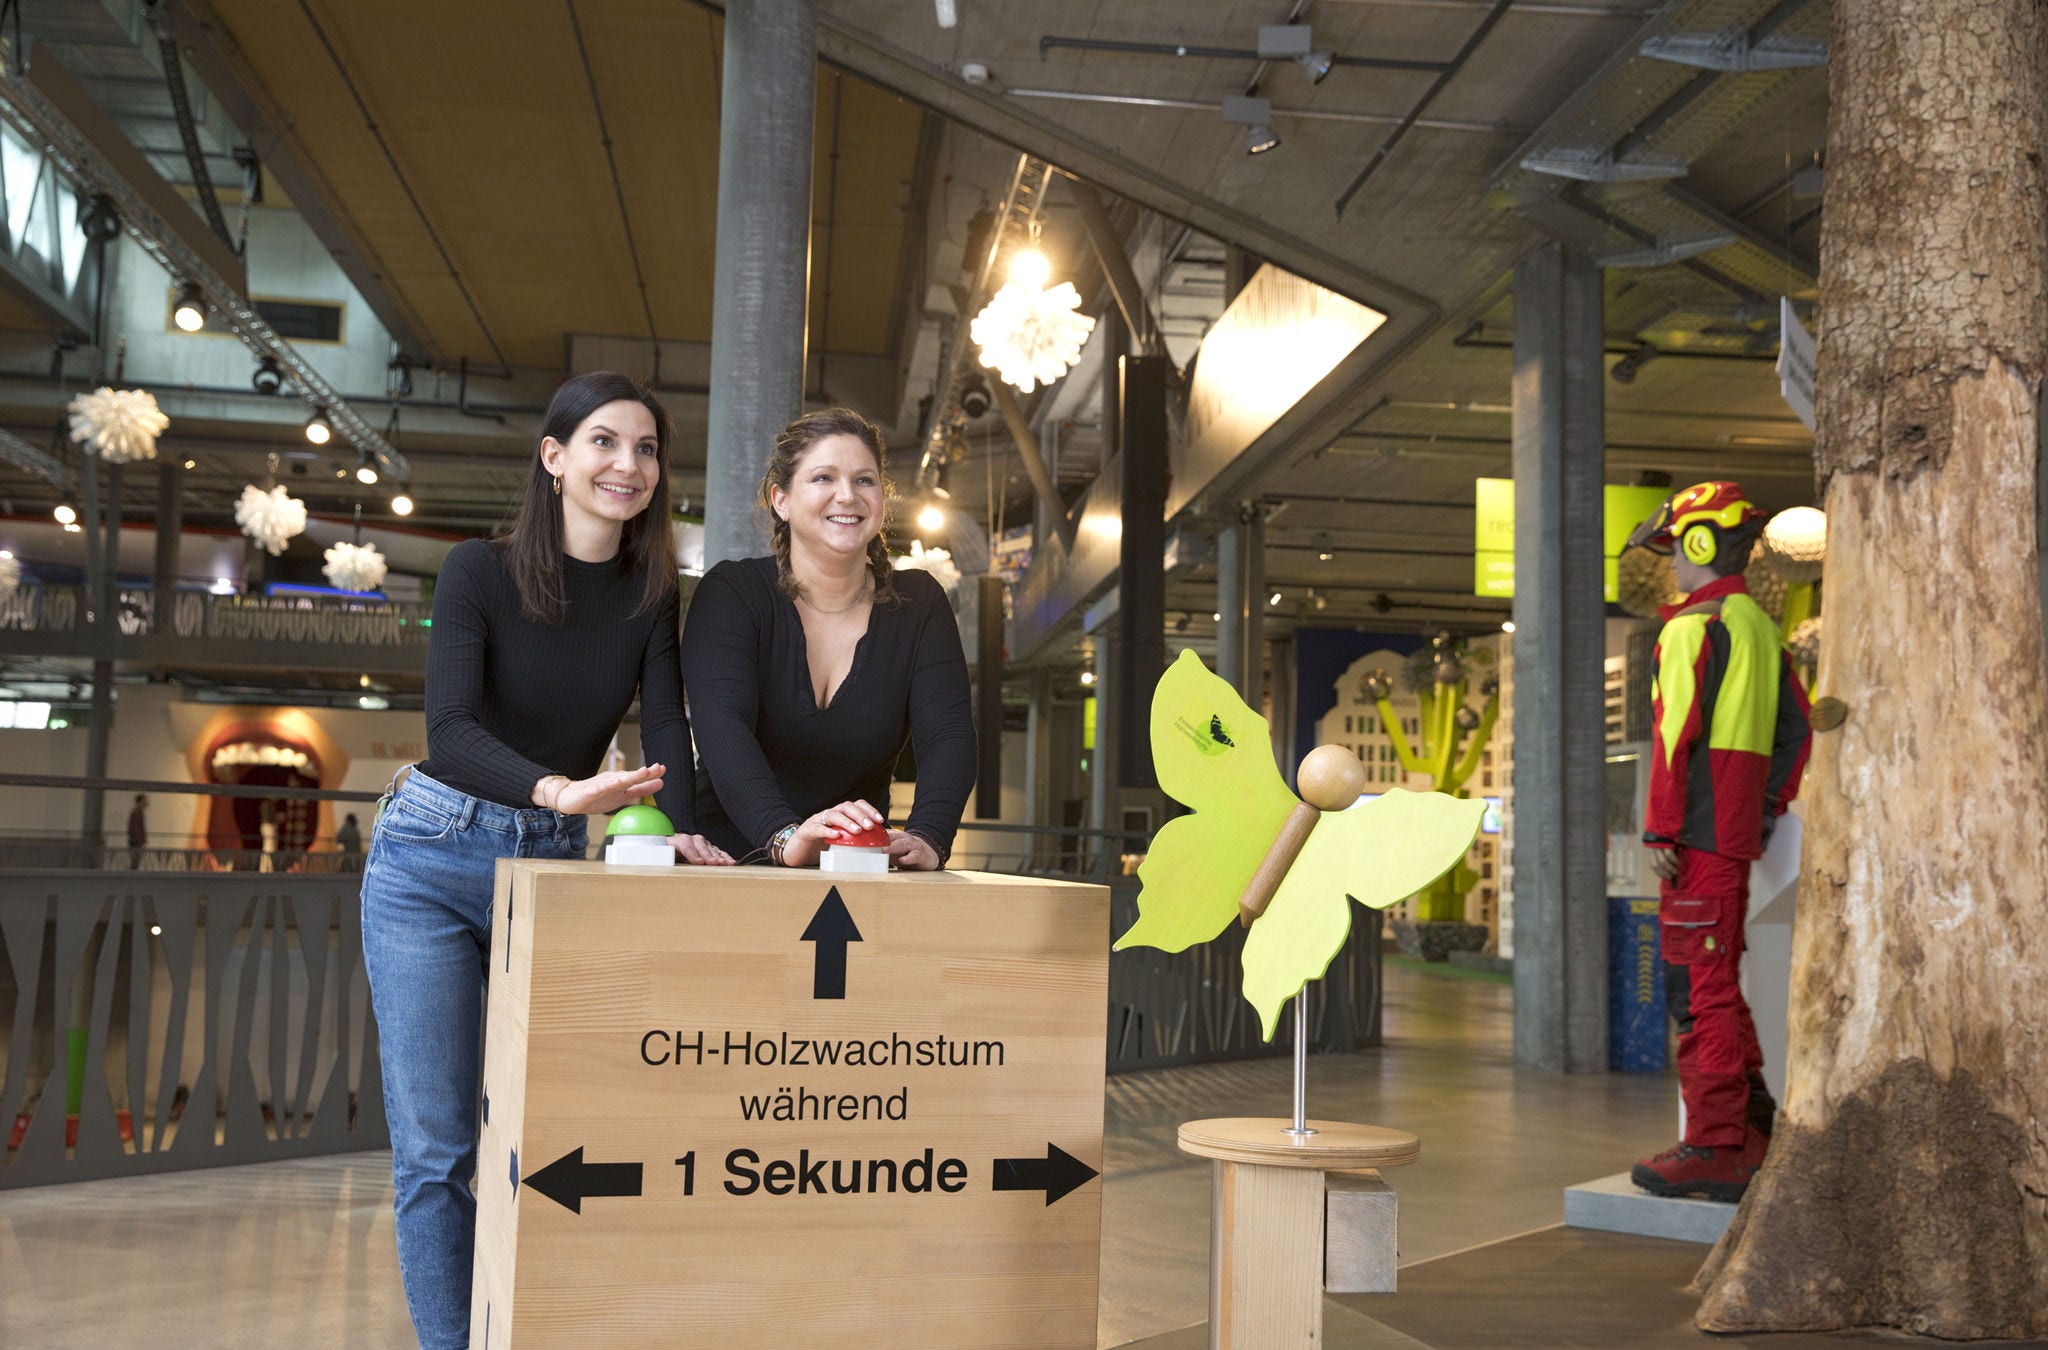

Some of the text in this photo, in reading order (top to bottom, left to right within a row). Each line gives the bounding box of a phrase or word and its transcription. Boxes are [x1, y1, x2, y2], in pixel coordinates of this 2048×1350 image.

[640, 1030, 1005, 1066] CH-Holzwachstum
[739, 1086, 908, 1122] während
[674, 1148, 968, 1196] 1 Sekunde
